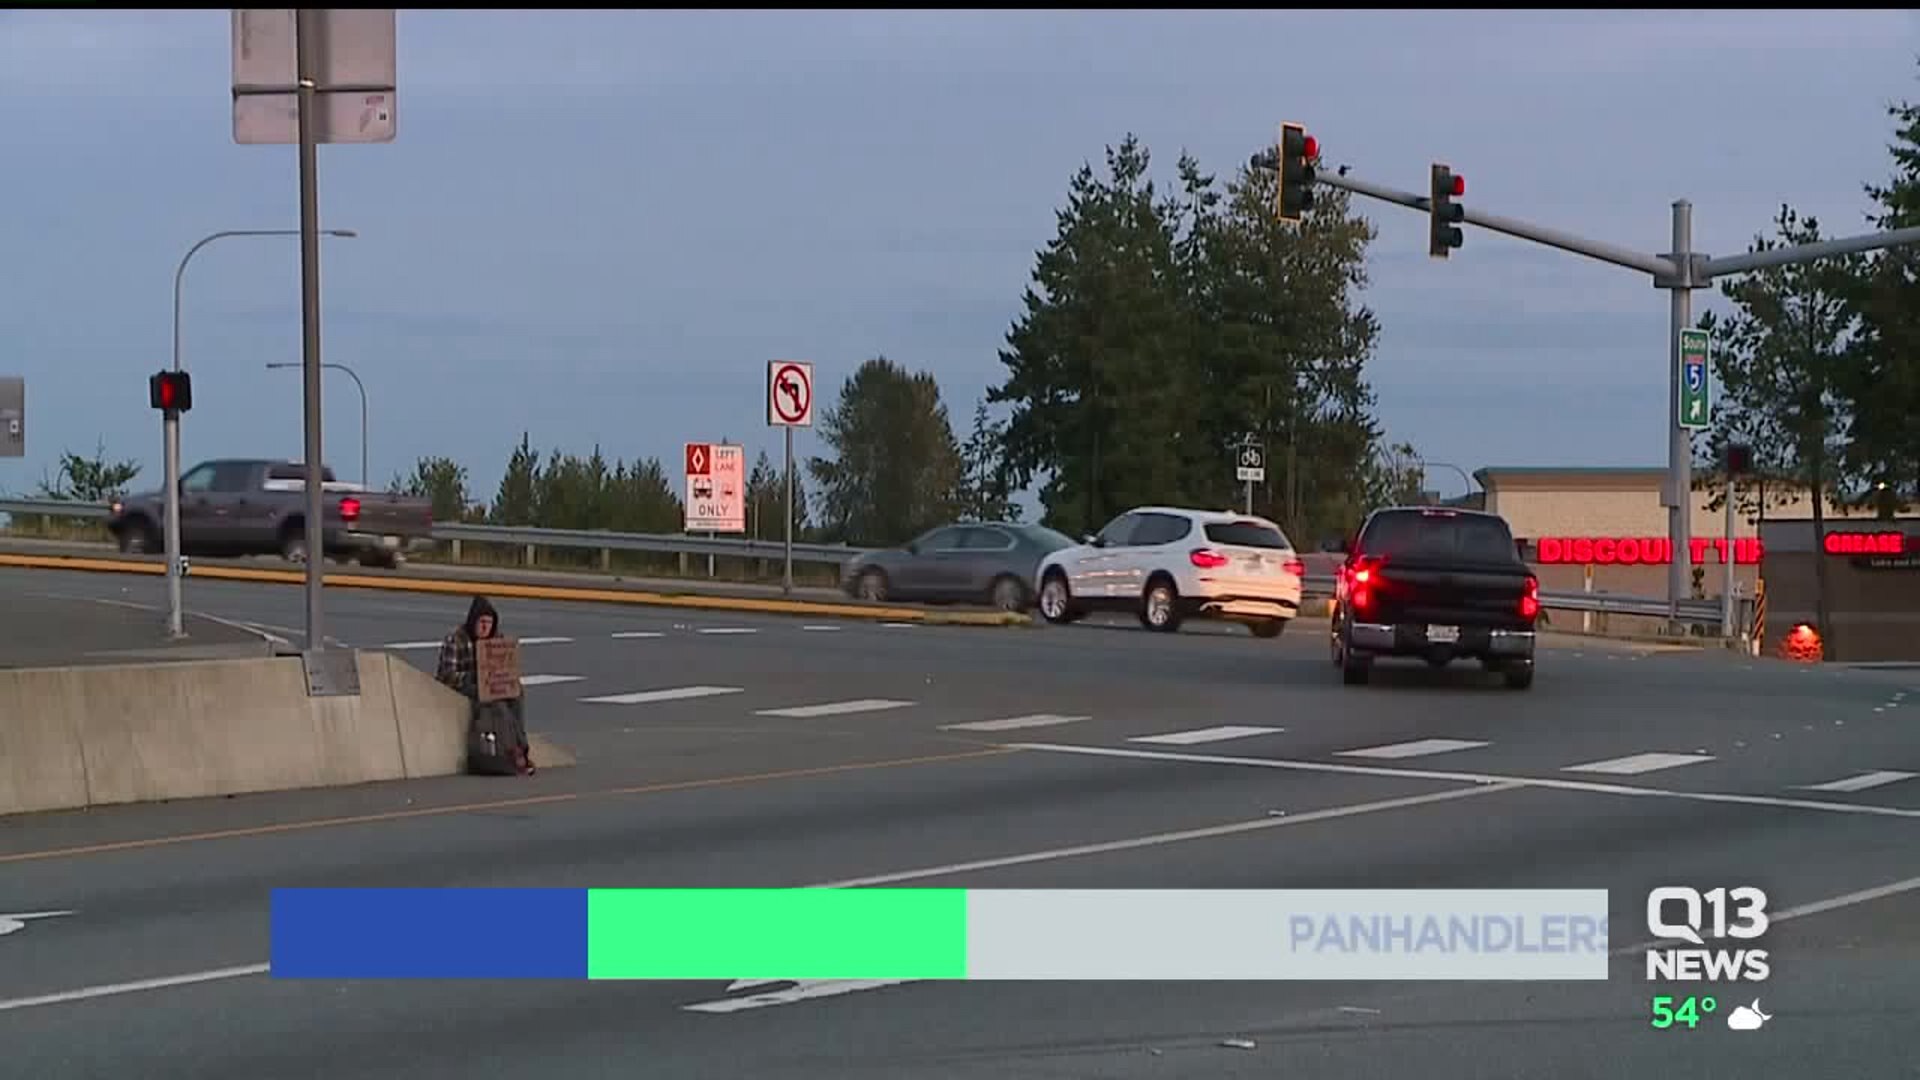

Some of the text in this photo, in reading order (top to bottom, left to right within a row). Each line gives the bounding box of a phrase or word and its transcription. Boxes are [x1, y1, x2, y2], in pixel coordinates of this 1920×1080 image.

[1684, 335, 1706, 350] South
[1690, 365, 1700, 389] 5
[715, 449, 735, 459] LEFT
[715, 463, 735, 472] LANE
[698, 504, 728, 517] ONLY
[1538, 537, 1709, 564] DISCOUT
[1824, 532, 1904, 554] GREASE
